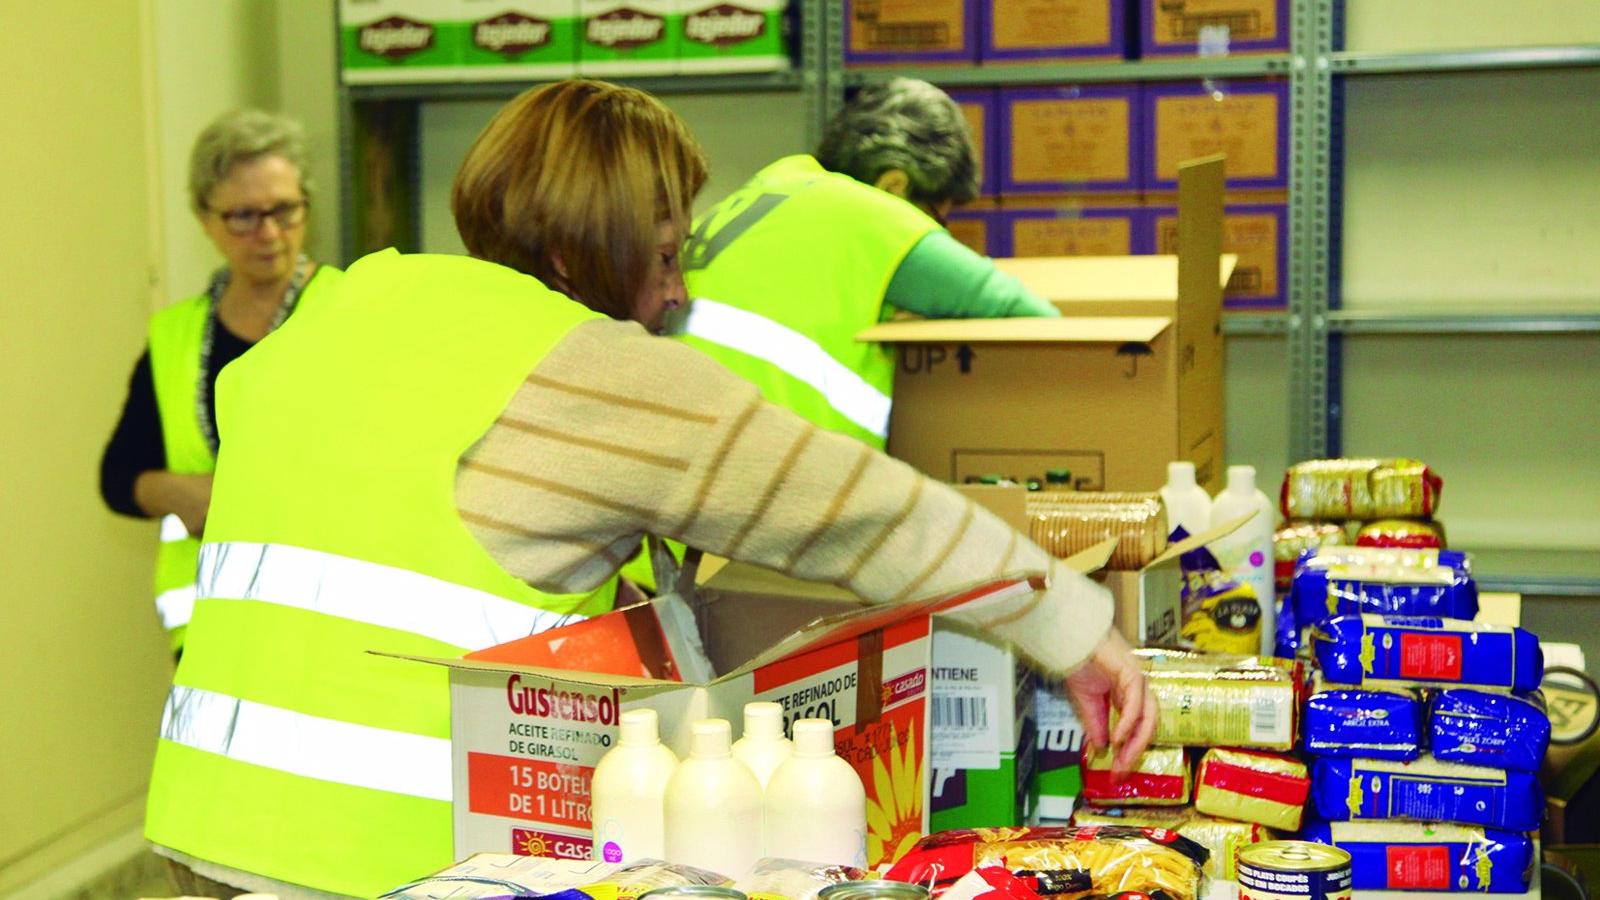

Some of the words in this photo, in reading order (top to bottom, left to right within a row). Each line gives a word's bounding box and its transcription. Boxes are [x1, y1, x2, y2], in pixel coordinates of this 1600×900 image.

[902, 344, 947, 374] UP
[507, 673, 620, 727] Gustensol
[793, 678, 842, 709] REFINADO
[844, 672, 857, 690] DE
[509, 722, 549, 740] ACEITE
[550, 727, 611, 747] REFINADO
[510, 740, 526, 754] DE
[528, 742, 579, 761] GIRASOL
[510, 765, 533, 788] 15
[510, 793, 532, 814] DE
[537, 794, 545, 816] 1
